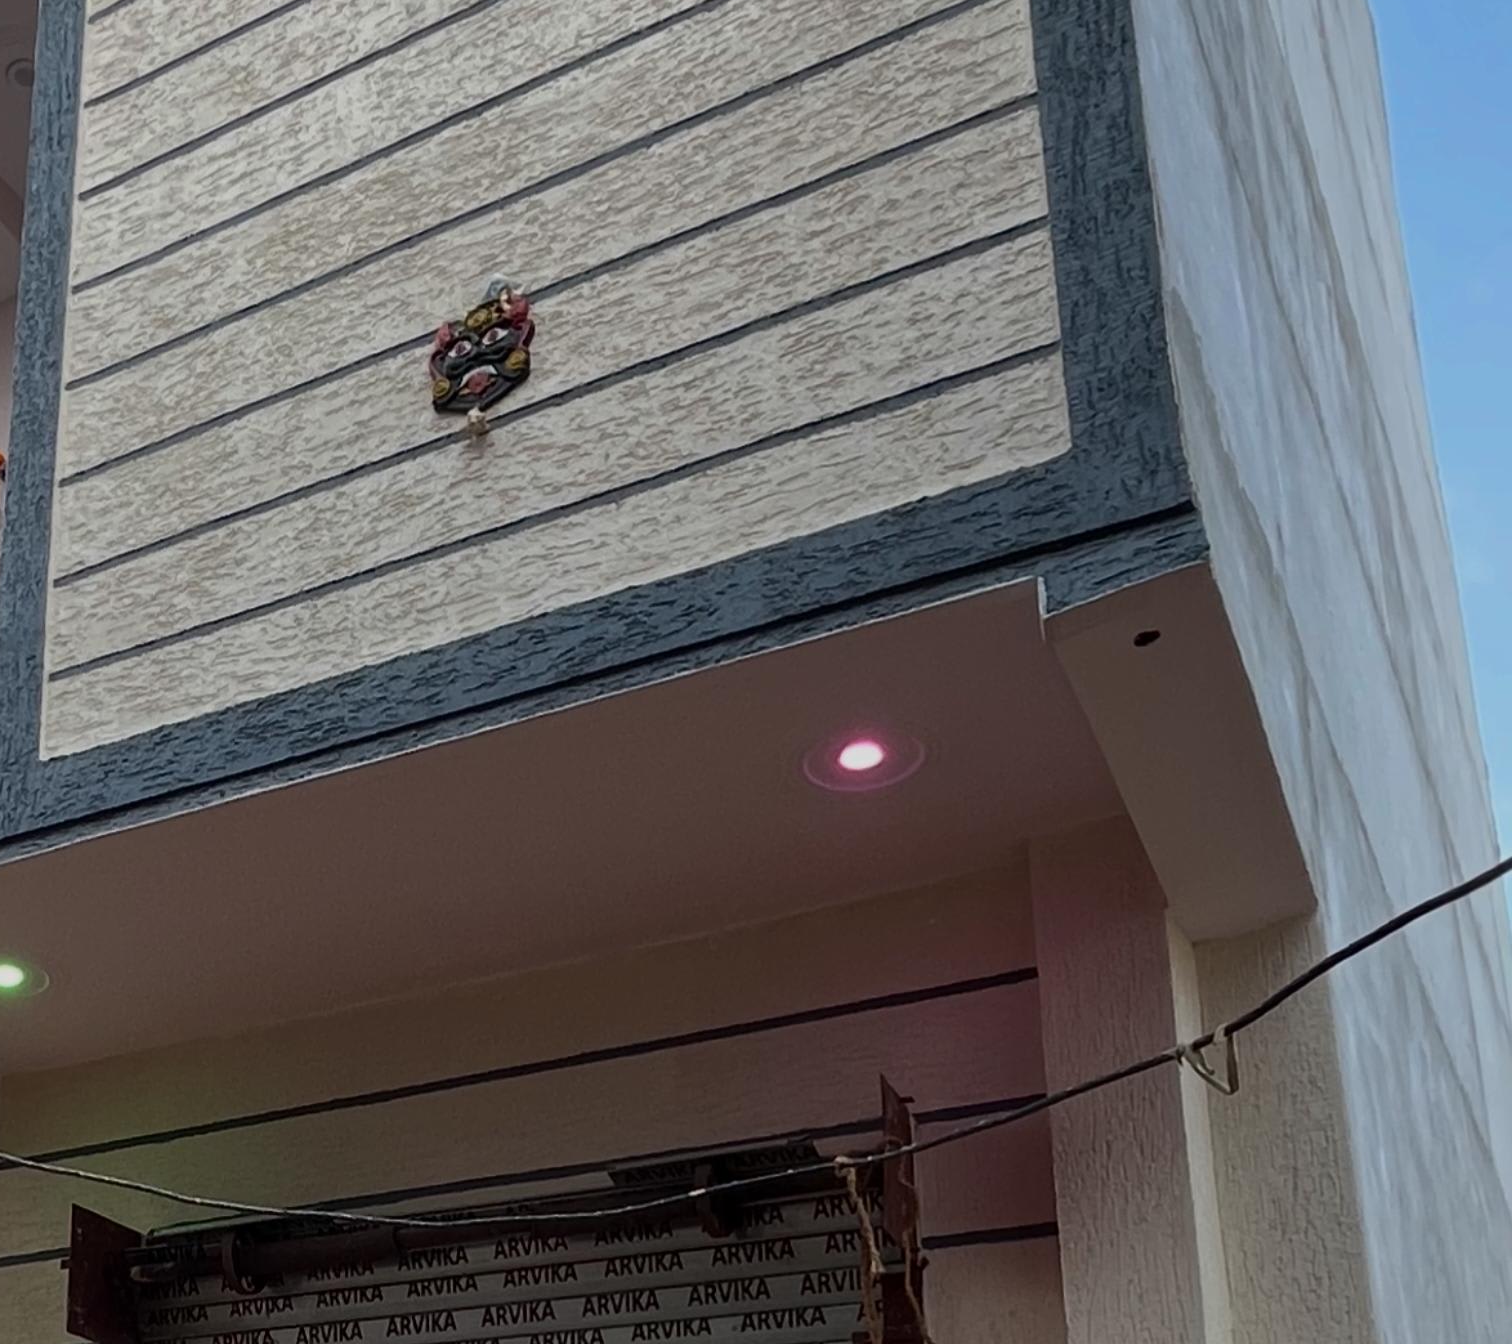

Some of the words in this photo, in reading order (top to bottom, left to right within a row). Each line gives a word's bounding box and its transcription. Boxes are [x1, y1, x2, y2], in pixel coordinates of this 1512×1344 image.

[229, 1295, 294, 1317] ARVIKA
[316, 1285, 384, 1308] ARVIKA
[407, 1274, 478, 1298] ARVIKA
[503, 1263, 578, 1288] ARVIKA
[604, 1250, 683, 1277] ARVIKA
[711, 1238, 795, 1266] ARVIKA
[385, 1310, 457, 1337] ARVIKA
[481, 1299, 556, 1327] ARVIKA
[582, 1288, 660, 1317] ARVIKA
[688, 1277, 770, 1306] ARVIKA
[631, 1317, 712, 1341] ARVIKA
[740, 1306, 826, 1332] ARVIKA
